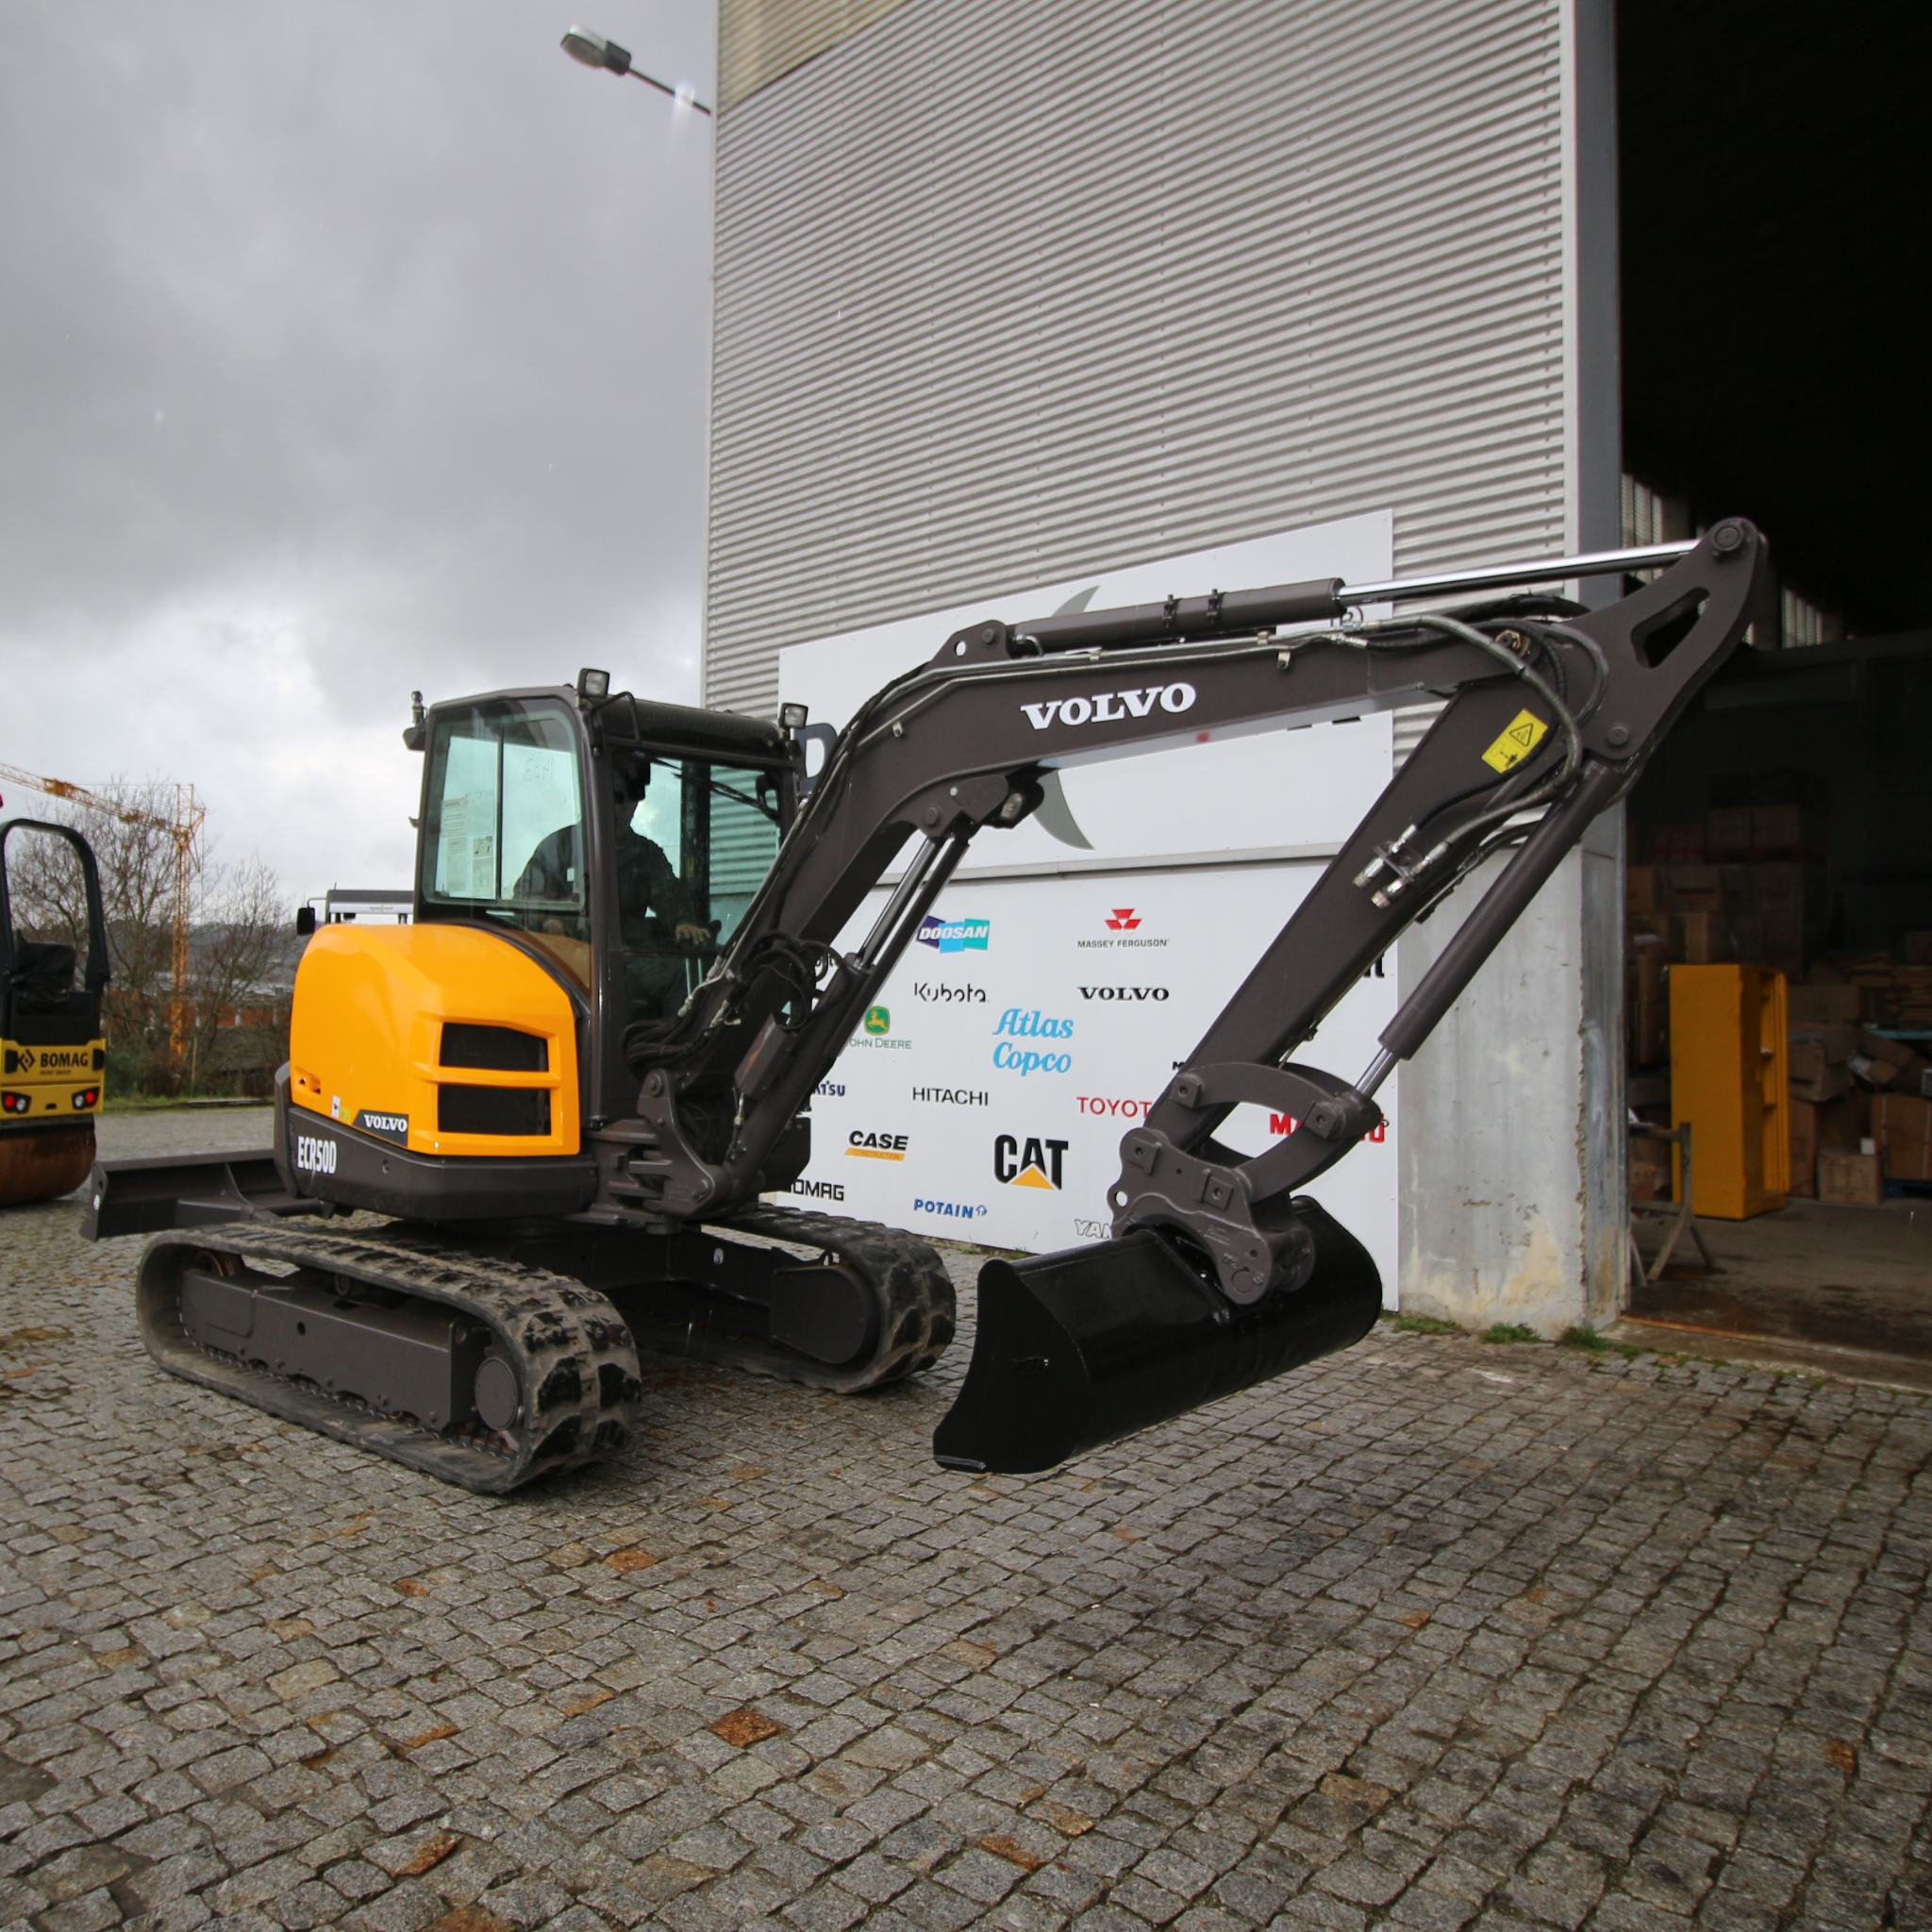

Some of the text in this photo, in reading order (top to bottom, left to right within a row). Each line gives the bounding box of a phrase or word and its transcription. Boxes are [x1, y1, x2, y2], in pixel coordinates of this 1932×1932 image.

[1020, 682, 1197, 730] VOLVO
[918, 925, 989, 941] DOOSAN
[1117, 940, 1167, 948] FERGUSON
[913, 982, 987, 1003] Kubota
[1077, 987, 1170, 1001] VOLVO
[991, 1008, 1074, 1039] Atlas
[848, 1038, 912, 1049] OHN DEERE
[41, 1053, 89, 1068] BOMAG
[992, 1041, 1072, 1076] Copco
[912, 1087, 989, 1106] HITACHI
[1076, 1097, 1153, 1118] TOYOT
[363, 1114, 408, 1132] VOLVO
[848, 1131, 909, 1150] CASE
[297, 1136, 337, 1174] ECR50D
[853, 1149, 901, 1160] CONSTRUCTION
[994, 1134, 1069, 1191] CAT
[792, 1178, 844, 1202] OMAG
[913, 1199, 974, 1219] POTAIN
[1074, 1219, 1112, 1240] YAN
